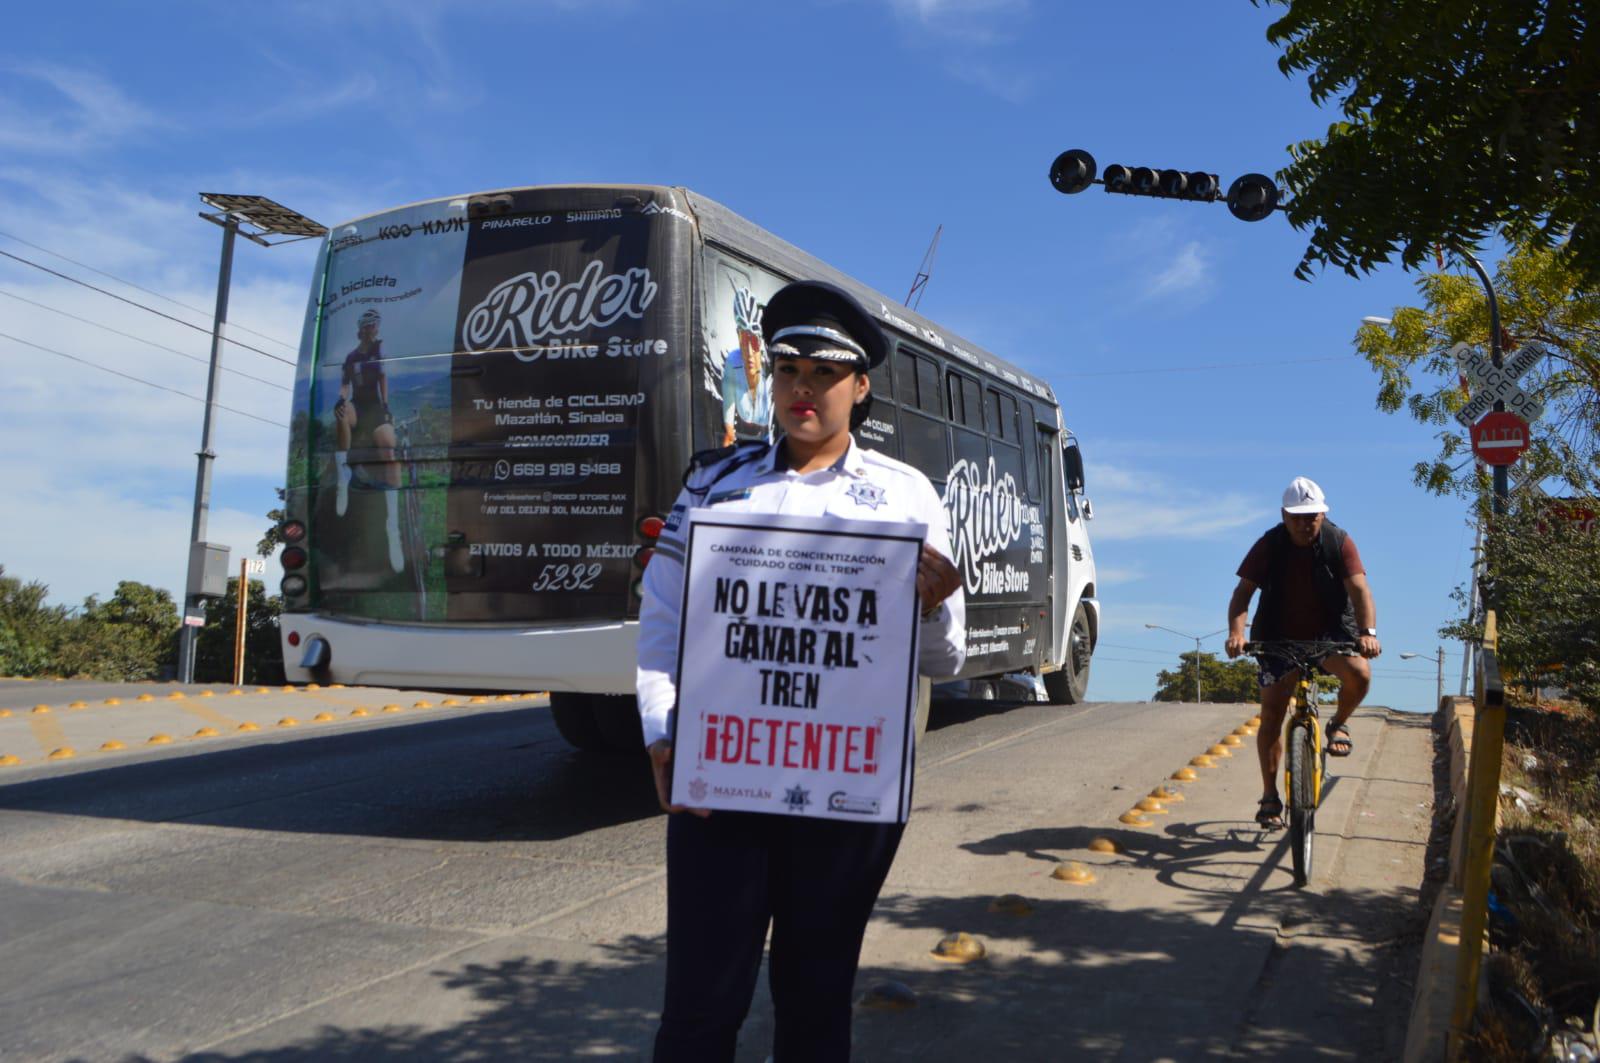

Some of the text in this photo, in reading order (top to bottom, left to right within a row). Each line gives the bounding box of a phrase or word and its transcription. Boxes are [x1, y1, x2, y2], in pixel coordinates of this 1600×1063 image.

[481, 208, 623, 230] PINARELLO SHIMANO
[341, 274, 398, 296] bicicleta
[463, 260, 657, 362] Rider
[547, 335, 669, 360] Bike Store
[1456, 346, 1538, 418] CRUCE DE
[473, 393, 646, 411] Tu tienda de CICLISMO
[1455, 389, 1495, 424] FERRO
[568, 411, 625, 424] Sinaloa
[1479, 426, 1524, 442] ALTO
[513, 463, 545, 476] 669
[549, 463, 576, 476] 918
[941, 456, 1022, 595] Rider
[527, 544, 539, 557] A
[542, 544, 582, 557] TODO
[710, 544, 886, 565] CAMPAÑA DE CONCIENTIZACIÓN
[533, 563, 602, 592] 5232
[788, 561, 812, 573] CON
[814, 563, 828, 574] EL
[982, 562, 1029, 594] Bike Store
[714, 577, 878, 628] NO LE VAS A
[724, 621, 859, 670] GANAR AL
[759, 668, 820, 710] TREN
[704, 713, 878, 775] ¡DETENTE!
[713, 784, 772, 801] MAZATLÁN
